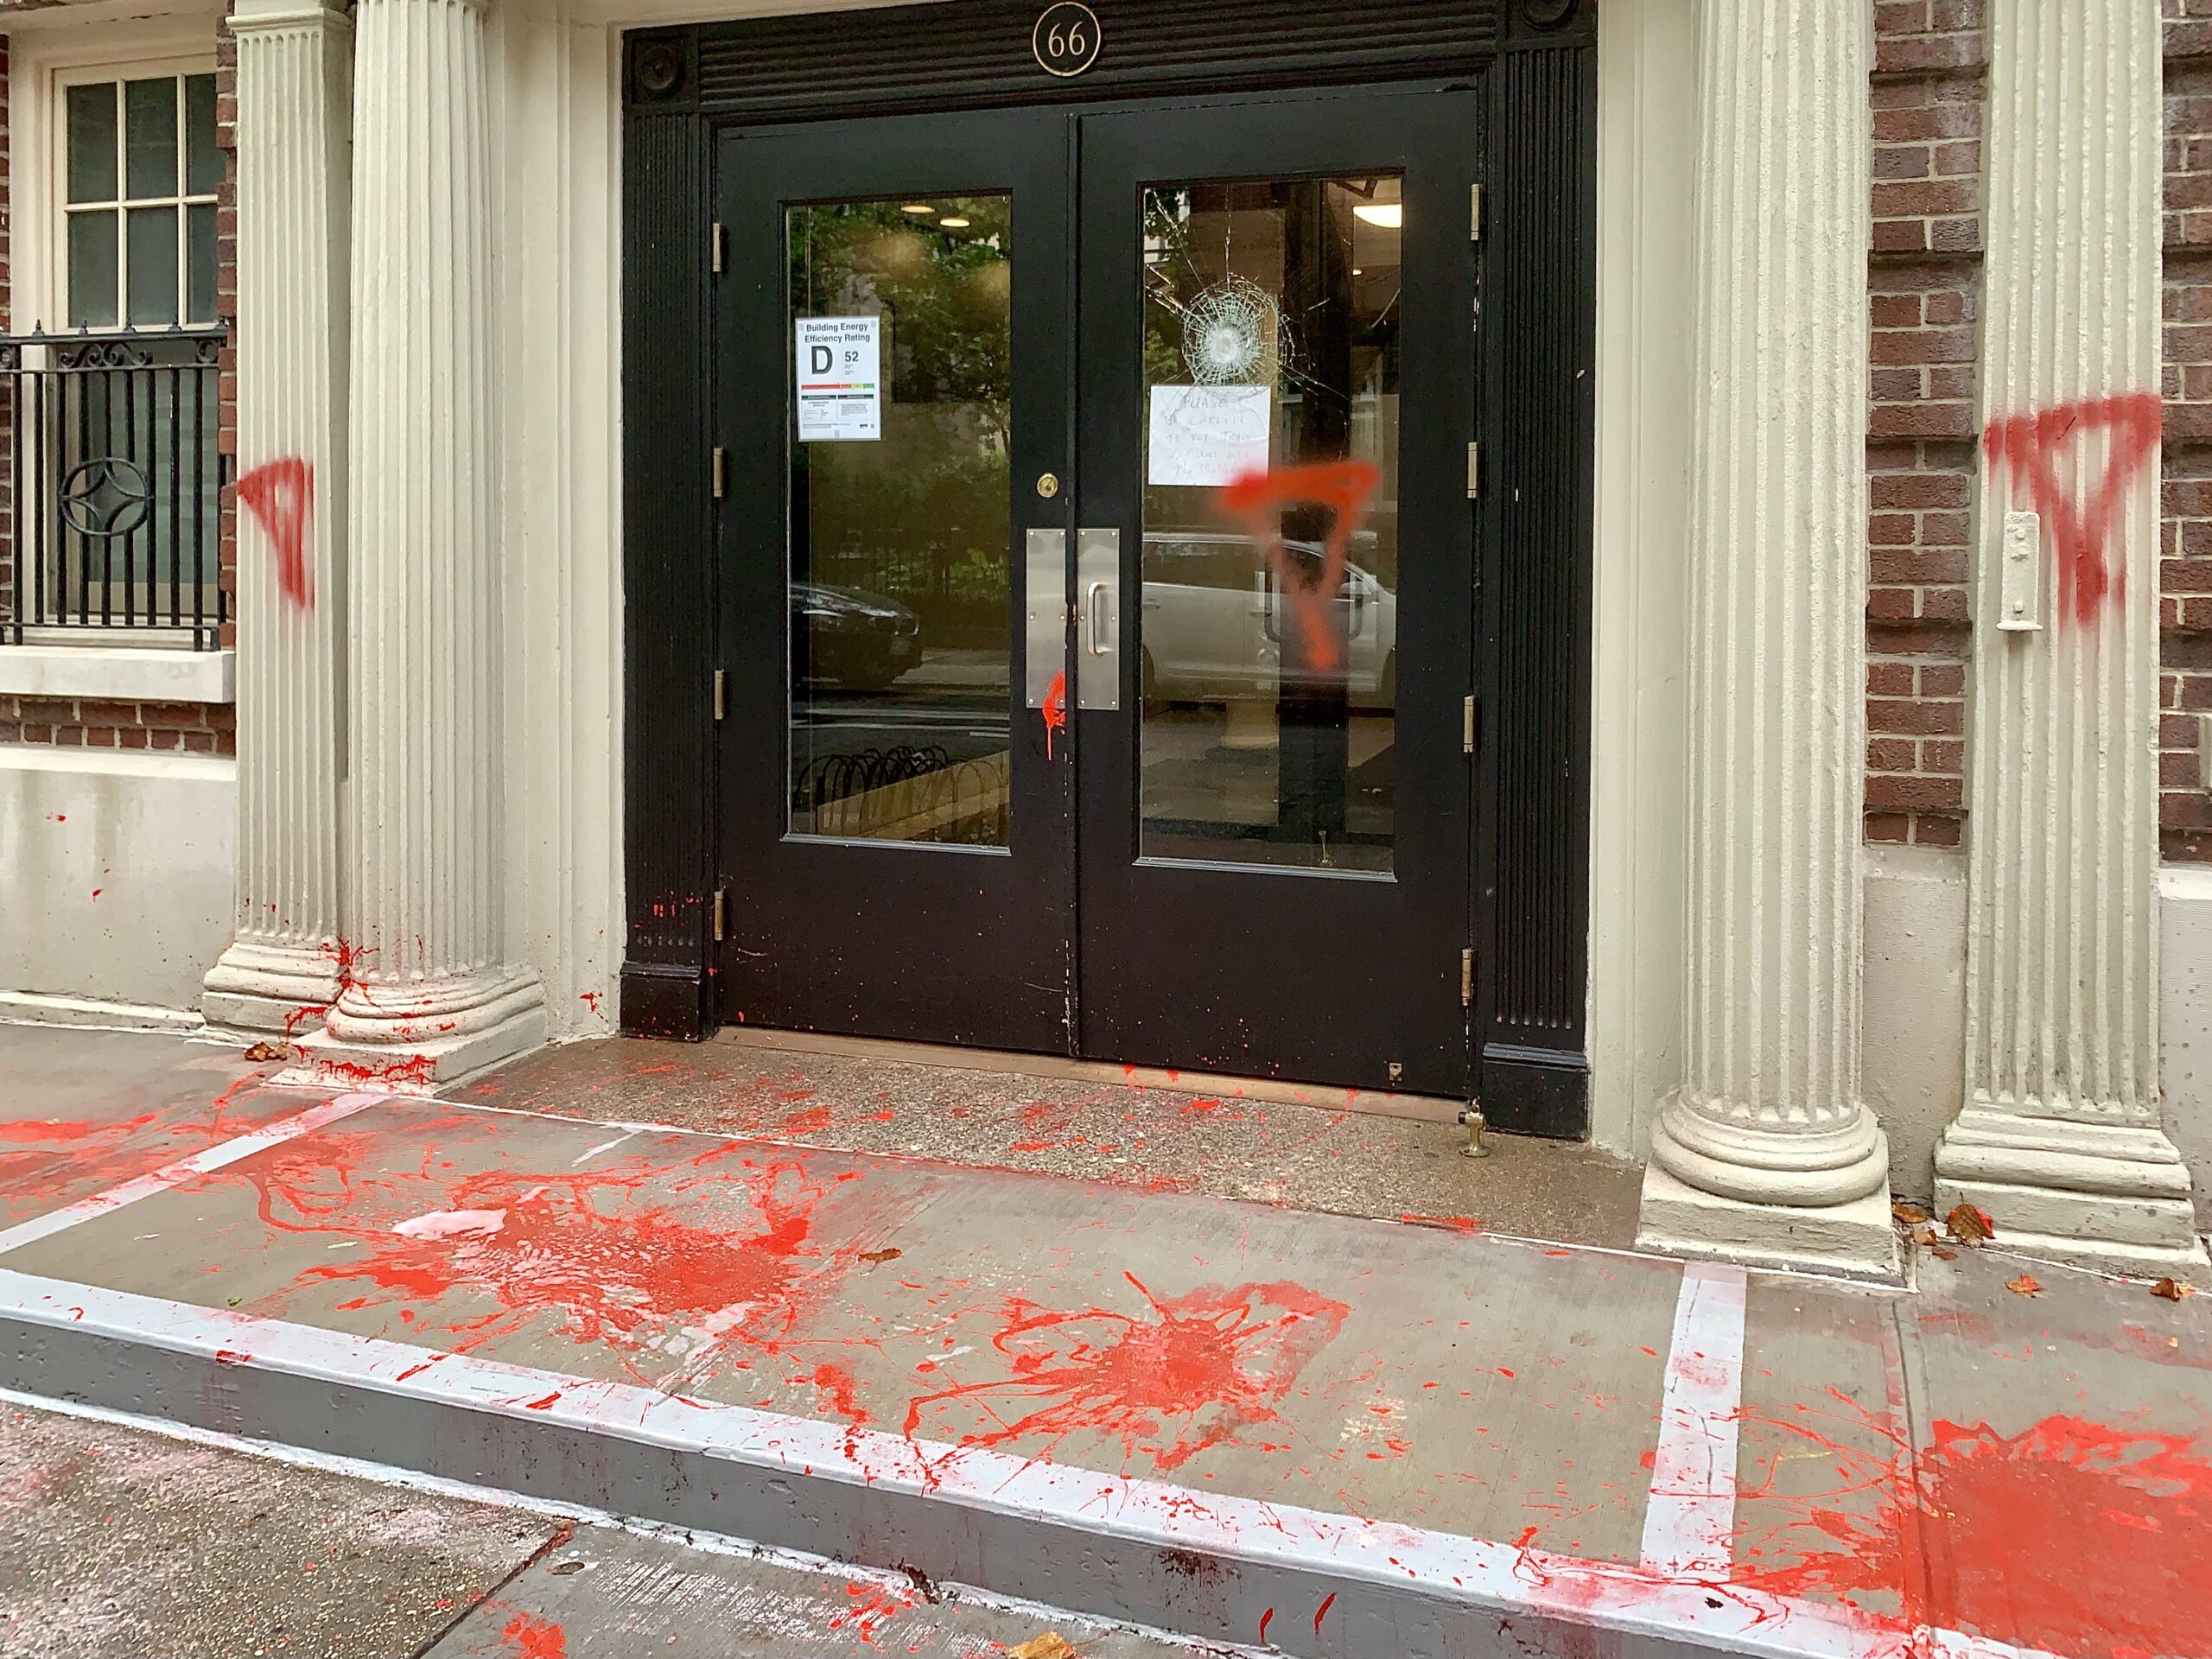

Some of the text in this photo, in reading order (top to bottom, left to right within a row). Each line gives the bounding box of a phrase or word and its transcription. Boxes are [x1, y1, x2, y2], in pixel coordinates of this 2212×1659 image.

[1048, 21, 1085, 58] 66
[806, 322, 868, 333] Building Energy
[804, 334, 871, 344] Efficiency Rating
[811, 345, 859, 375] D 52
[1183, 395, 1227, 409] PLEASE
